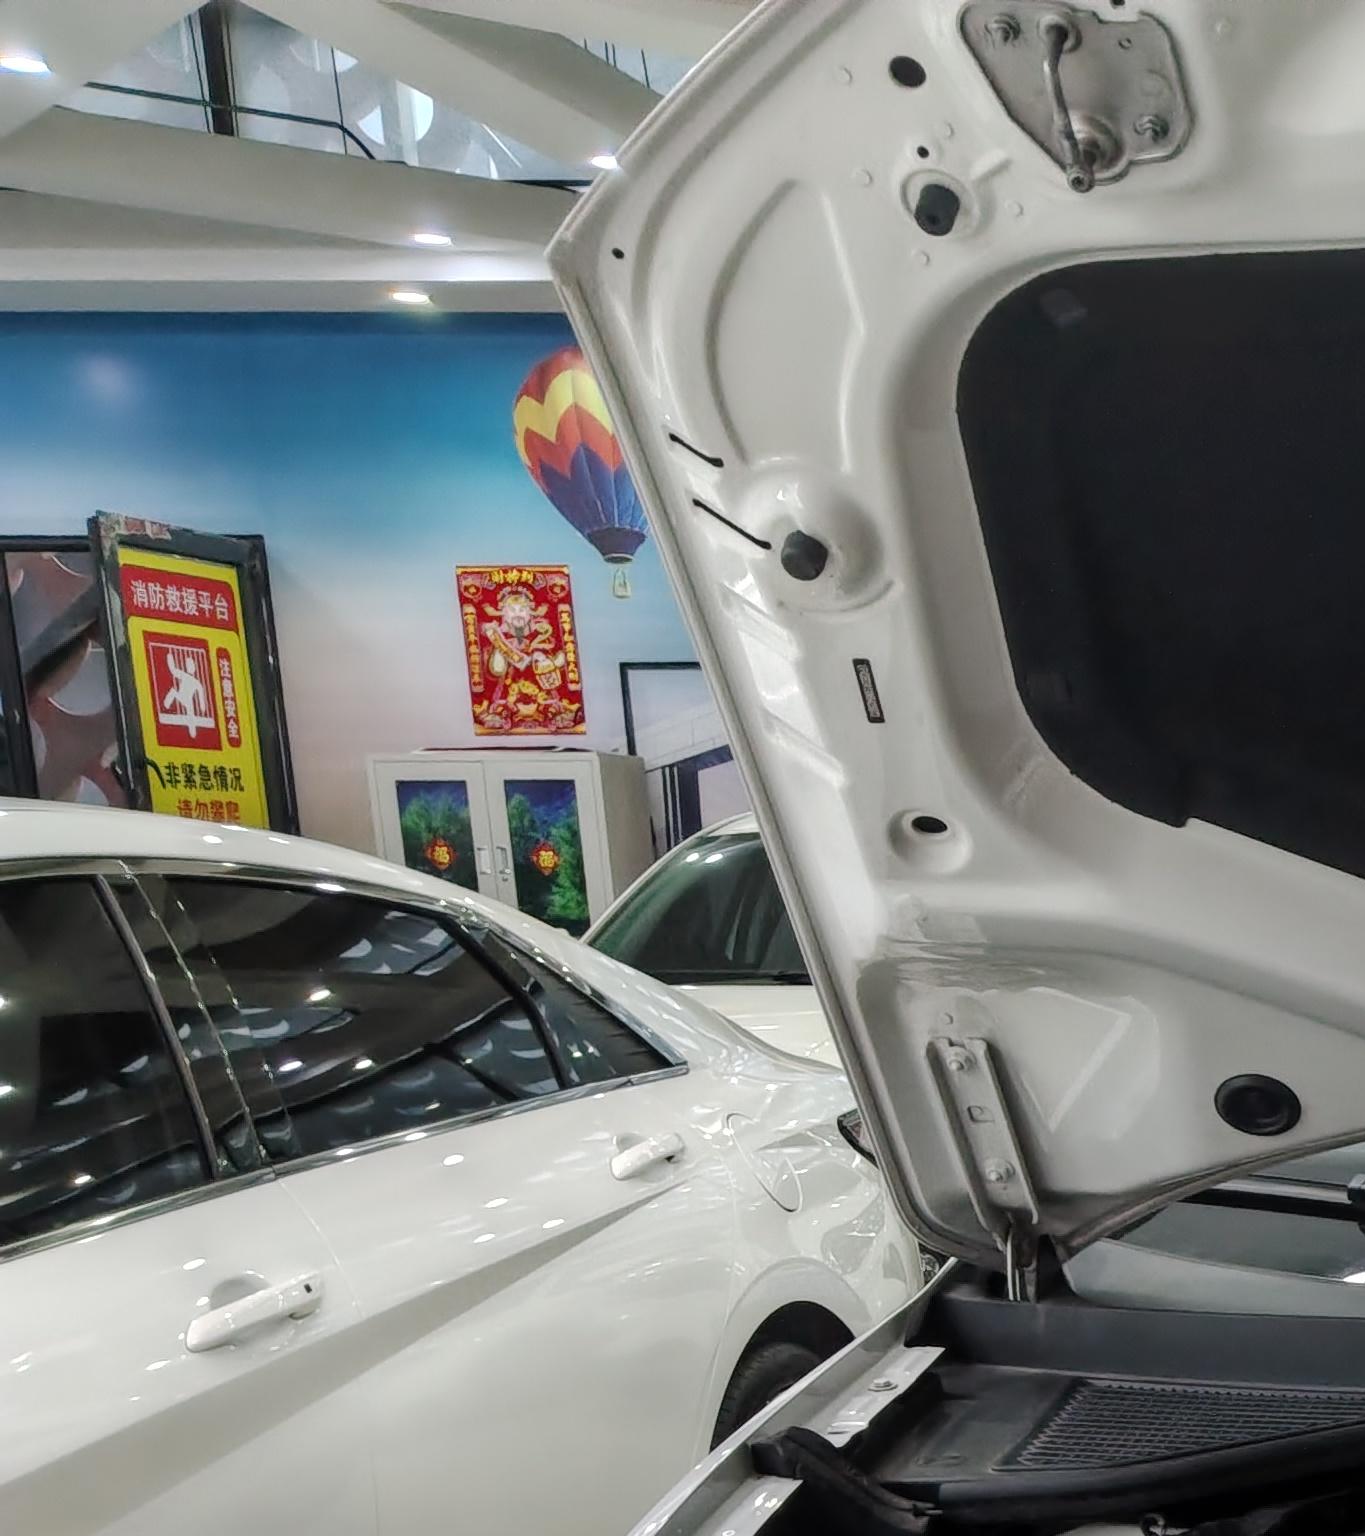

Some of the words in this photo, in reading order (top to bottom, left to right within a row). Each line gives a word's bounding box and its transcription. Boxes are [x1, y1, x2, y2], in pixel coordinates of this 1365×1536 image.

[130, 579, 229, 621] 消防救援平台
[218, 657, 240, 738] 注意安全
[164, 762, 245, 792] 非紧急情况
